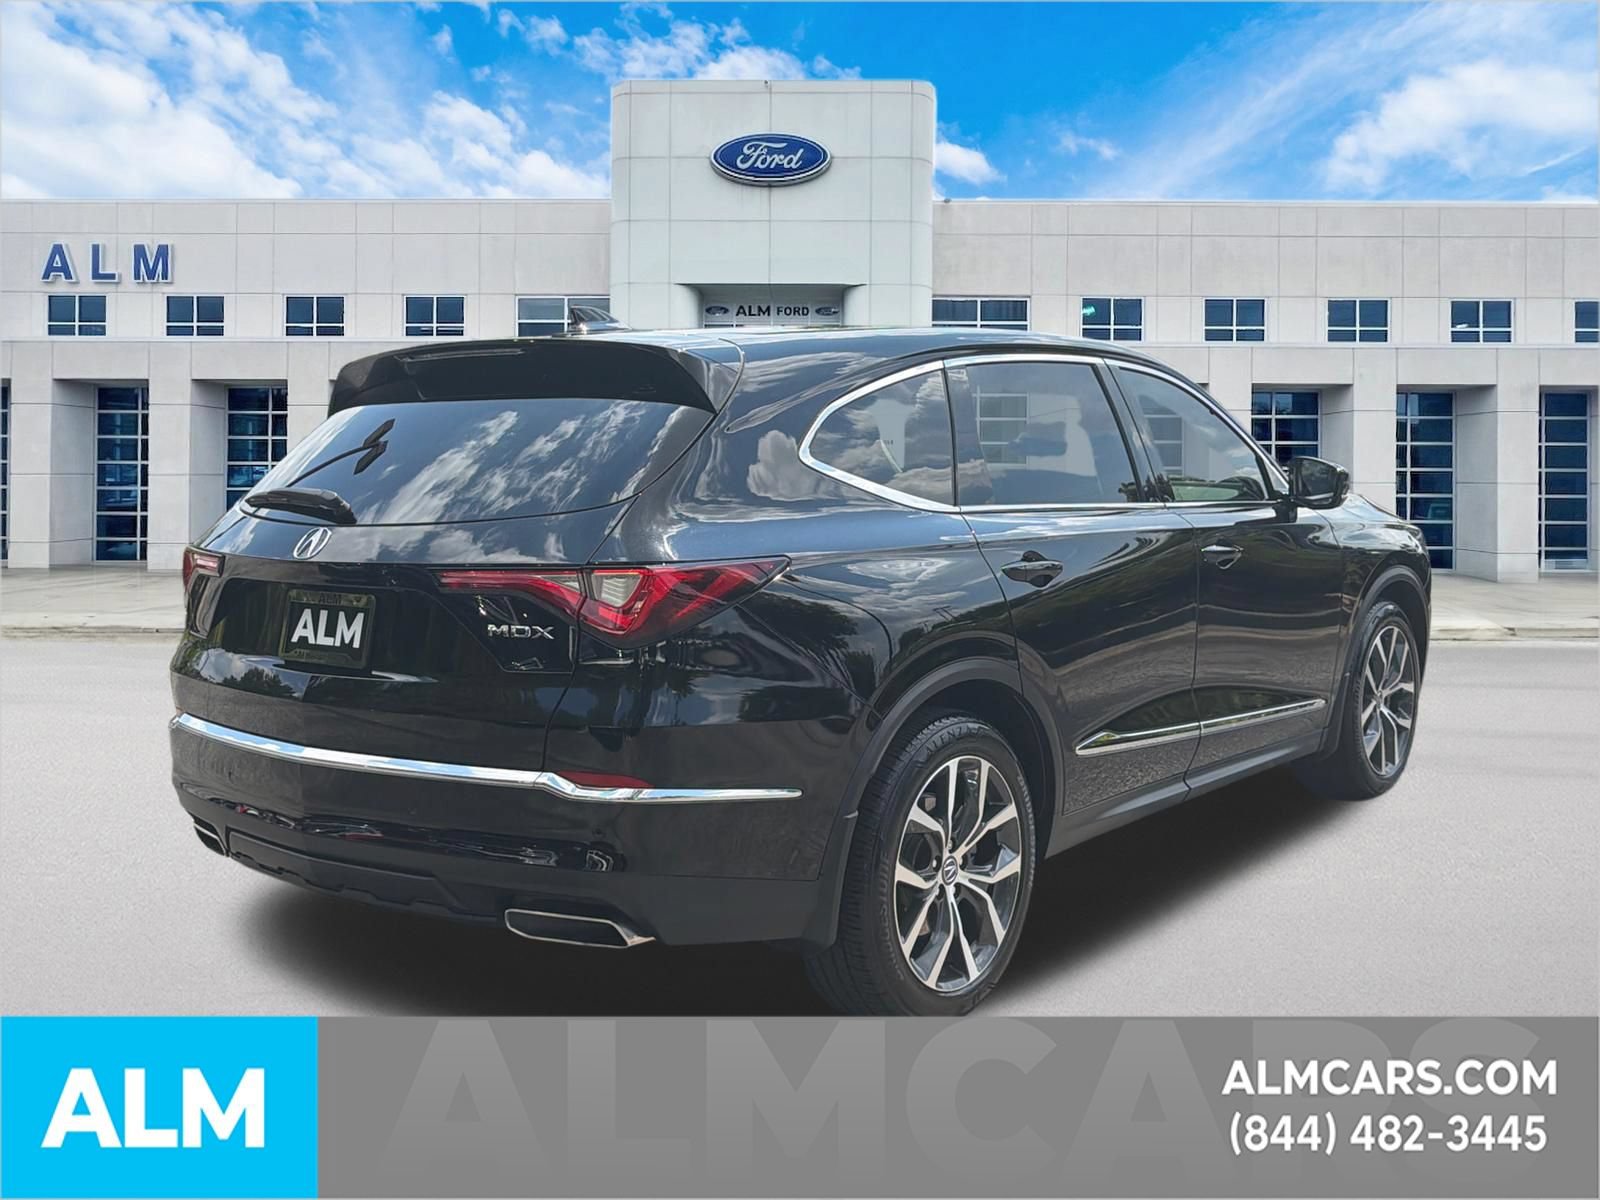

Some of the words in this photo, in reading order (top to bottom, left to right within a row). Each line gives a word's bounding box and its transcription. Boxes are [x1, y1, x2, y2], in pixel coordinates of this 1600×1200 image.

[736, 141, 804, 169] Ford
[42, 244, 171, 282] ALM
[735, 305, 771, 316] ALM
[776, 306, 810, 316] FORD
[290, 608, 364, 649] ALM
[487, 624, 555, 640] MDX
